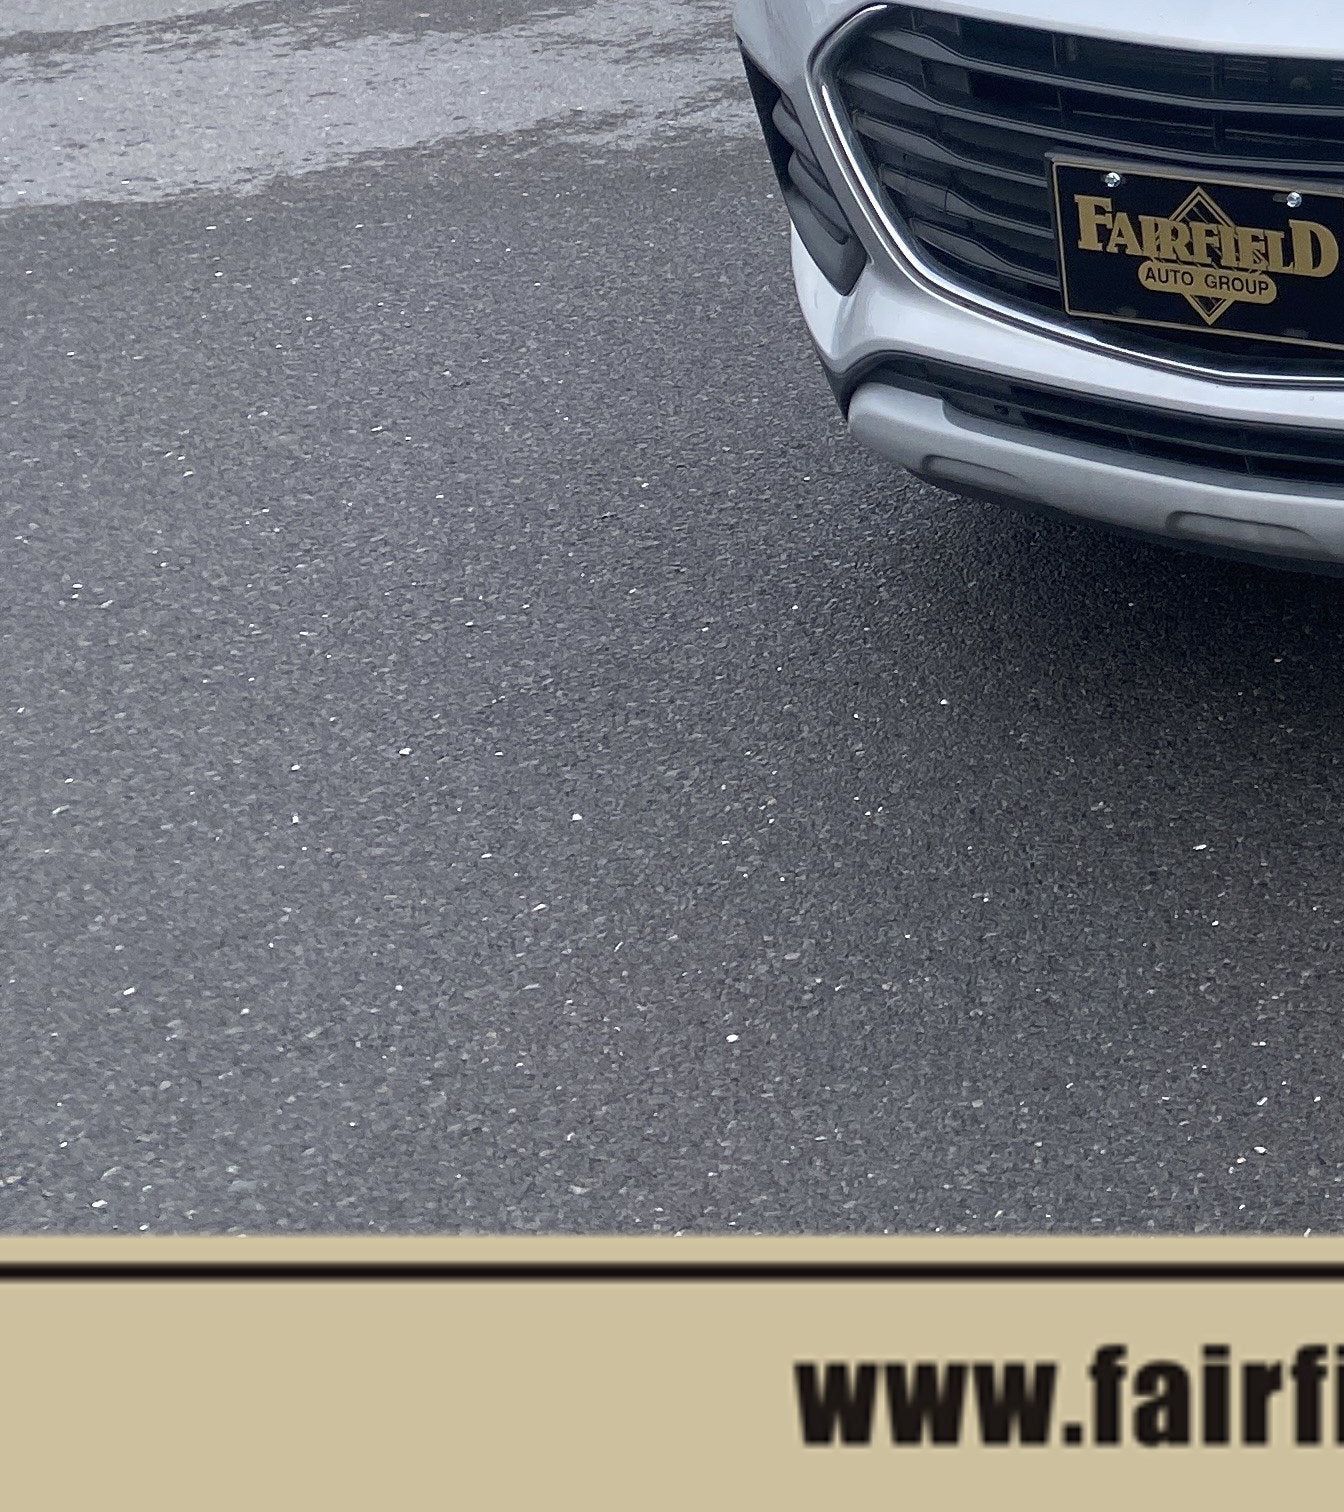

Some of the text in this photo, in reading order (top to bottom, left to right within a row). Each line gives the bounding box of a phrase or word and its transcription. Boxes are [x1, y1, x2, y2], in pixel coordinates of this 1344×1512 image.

[1073, 194, 1340, 278] FAIRFIELD
[1145, 267, 1269, 296] AUTO GROUP
